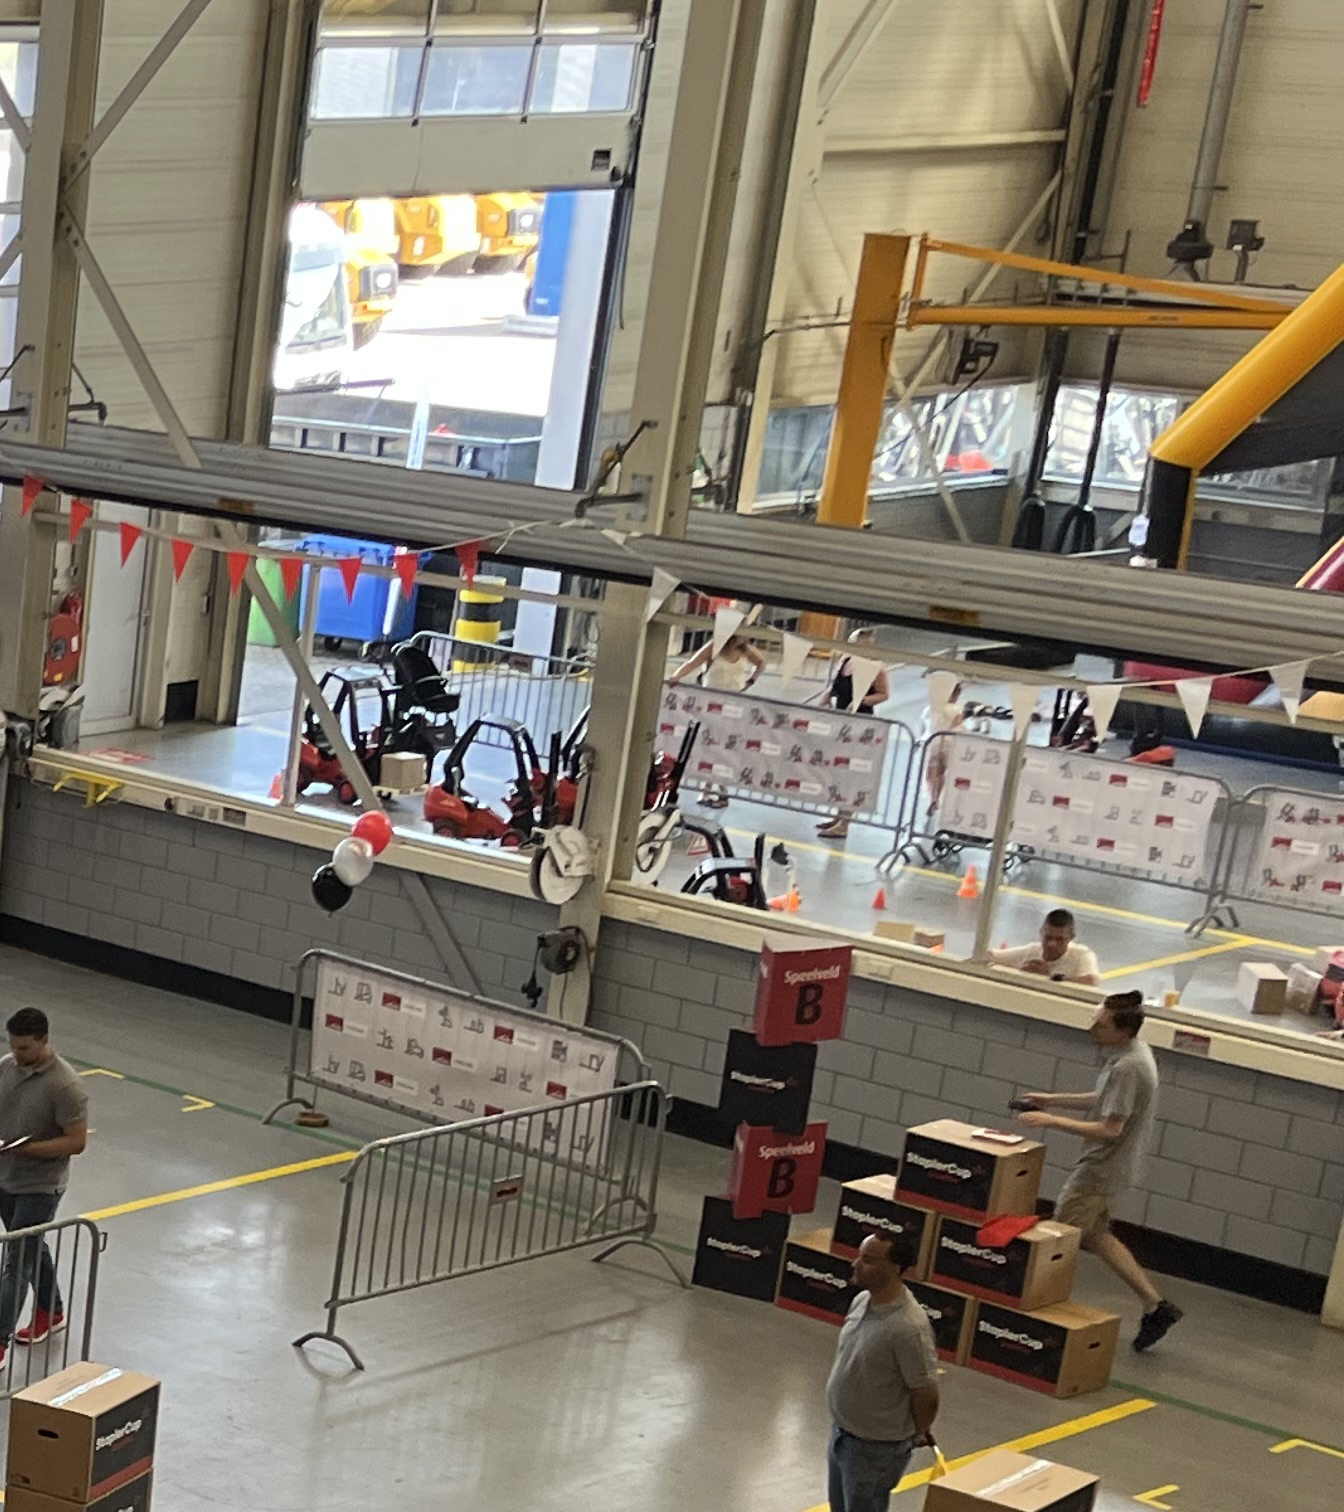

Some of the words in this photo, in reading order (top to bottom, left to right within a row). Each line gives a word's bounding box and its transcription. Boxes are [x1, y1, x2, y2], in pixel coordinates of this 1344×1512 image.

[784, 964, 841, 985] Speelveld
[795, 983, 824, 1026] B
[758, 1141, 815, 1160] Speelveld
[906, 1151, 973, 1180] StaplerCup
[766, 1157, 797, 1199] B
[841, 1204, 904, 1234] StaplerCup
[978, 1320, 1044, 1350] StaplerCup
